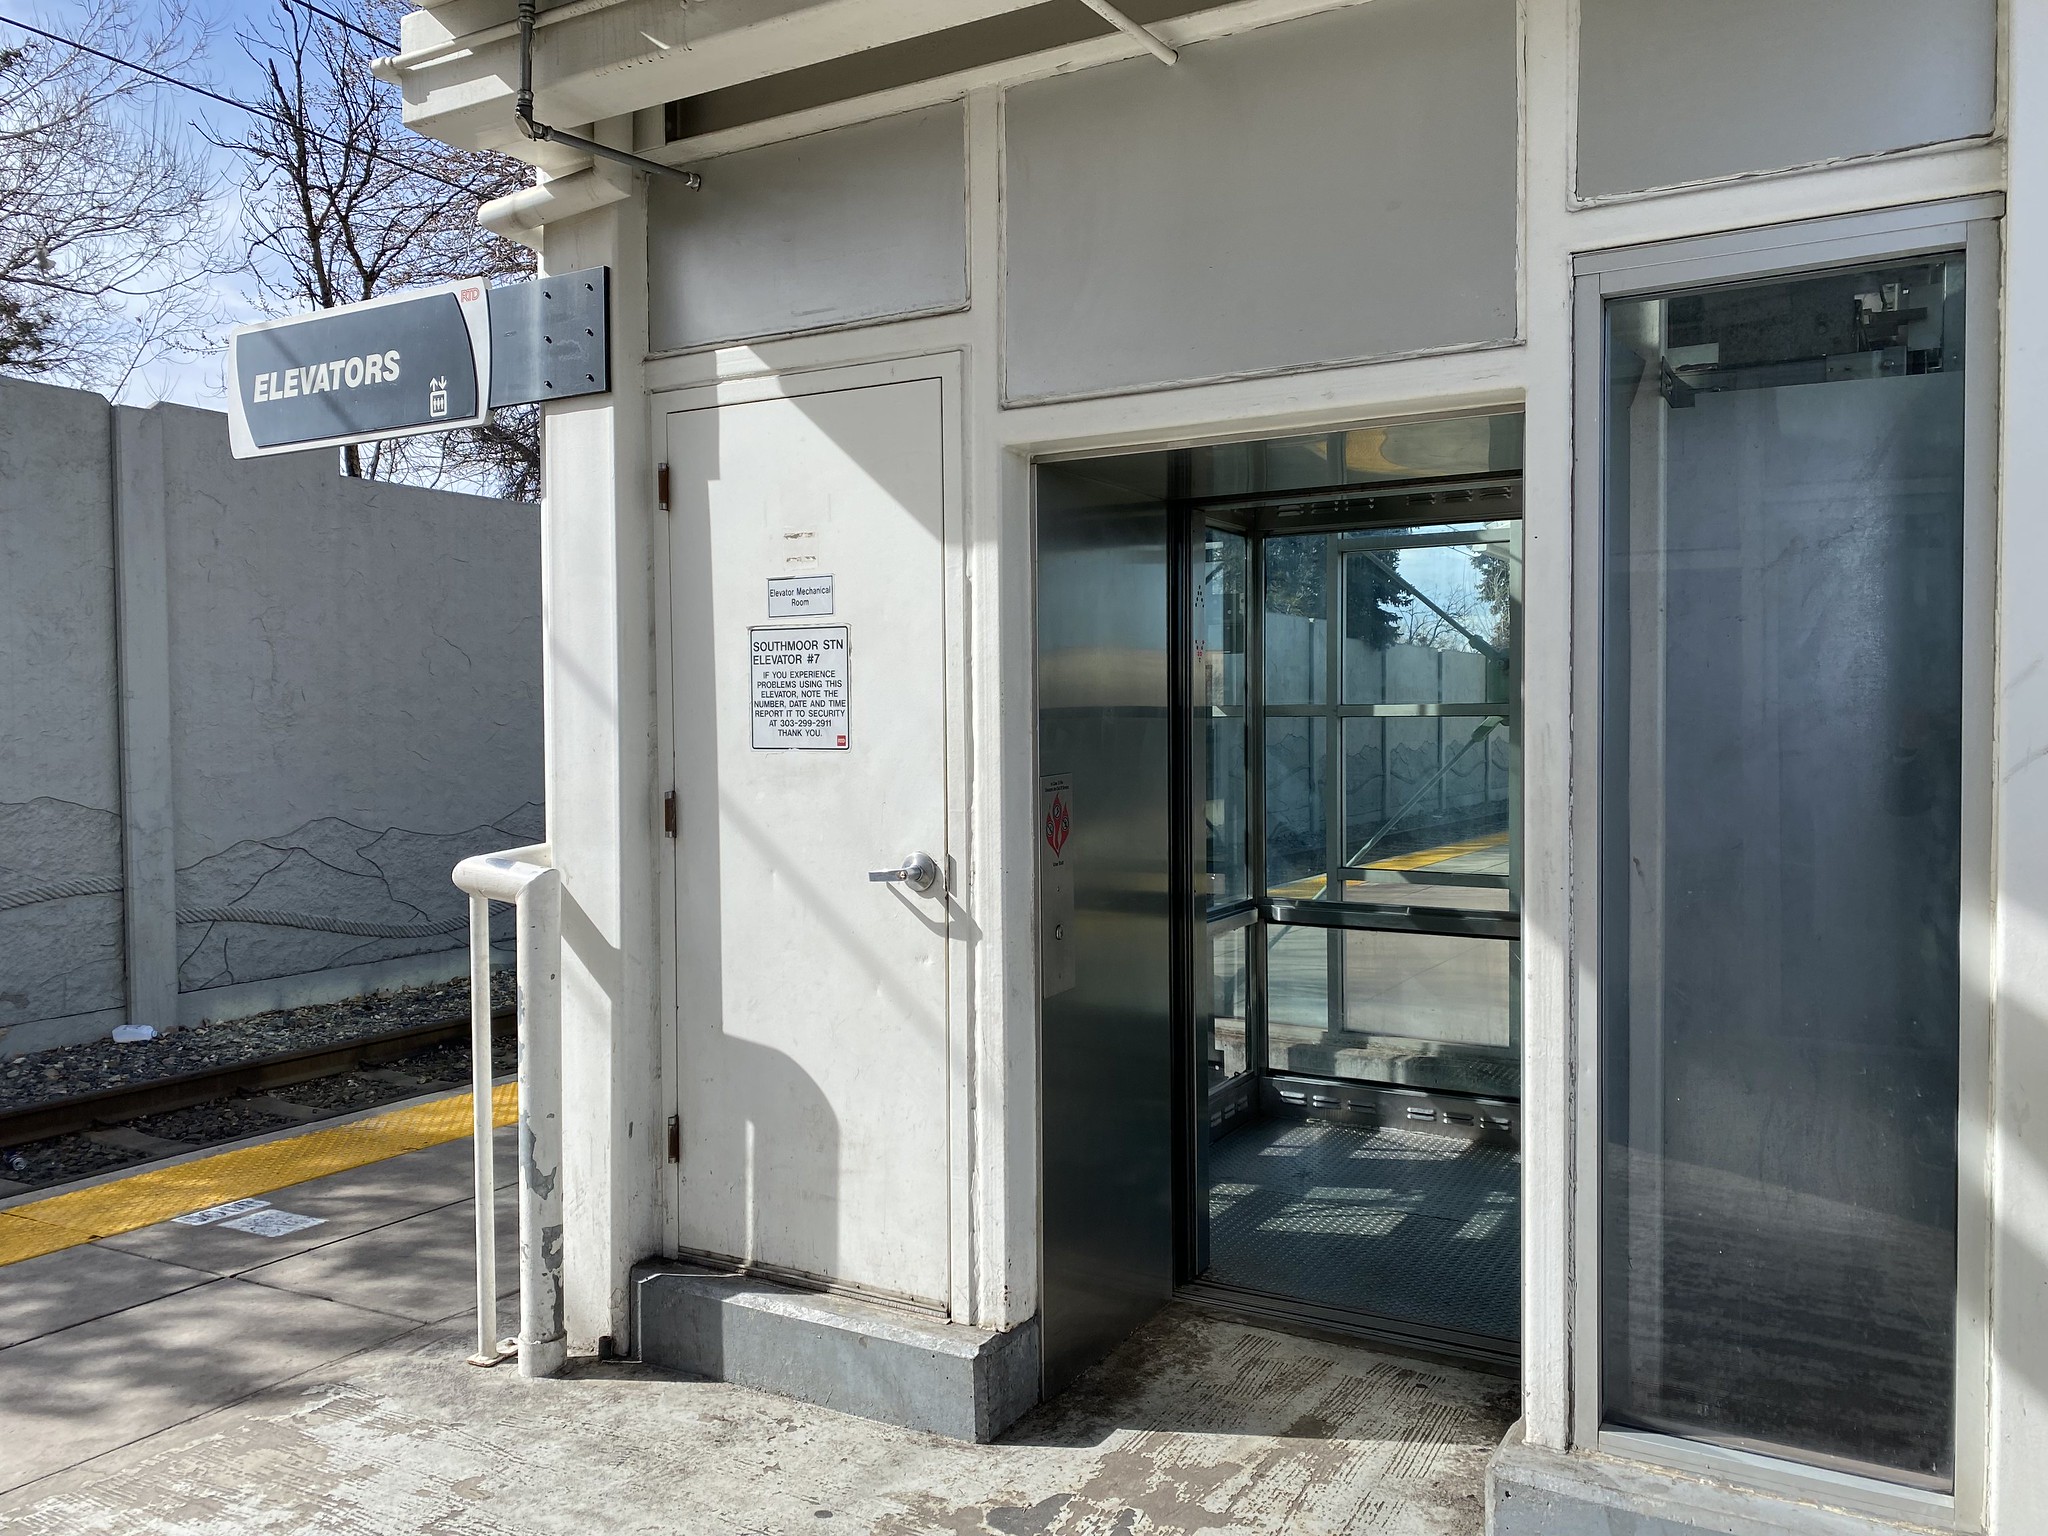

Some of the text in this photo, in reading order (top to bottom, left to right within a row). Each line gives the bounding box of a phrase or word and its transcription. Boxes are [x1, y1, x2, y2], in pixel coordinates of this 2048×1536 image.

[461, 288, 479, 302] RTD
[254, 350, 400, 403] ELEVATORS
[770, 586, 831, 597] Elevator Mechanical
[791, 598, 809, 606] Room
[753, 639, 844, 652] SOUTHMOOR STN
[753, 653, 820, 665] ELEVATOR #7
[763, 670, 835, 679] IF YOU EXPERIENCE
[757, 680, 842, 689] PROBLEMS USING THIS
[761, 690, 838, 699] ELEVATOR, NOTE THE
[754, 700, 787, 708] NUMBER,
[789, 700, 807, 708] DATE
[828, 699, 846, 707] TIME
[808, 709, 845, 717] SECURITY
[780, 719, 832, 727] 303-299-2911
[778, 729, 822, 737] THANK YOU.
